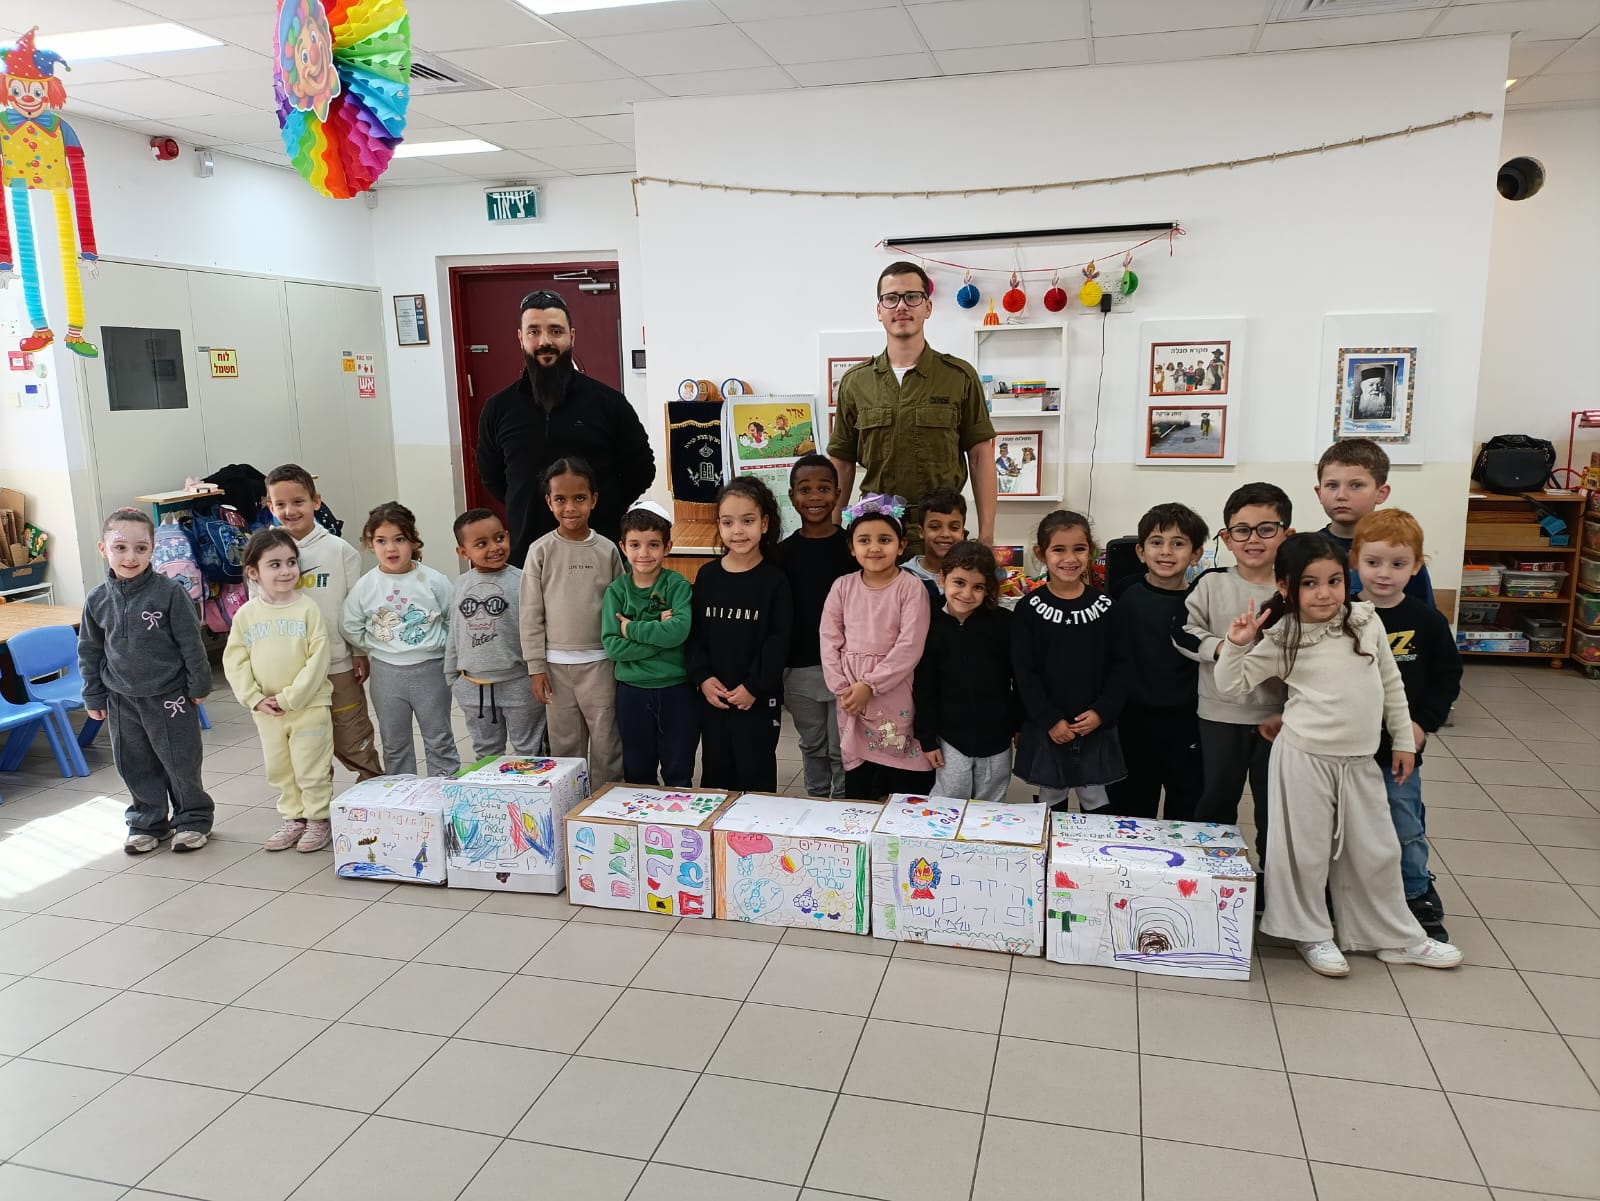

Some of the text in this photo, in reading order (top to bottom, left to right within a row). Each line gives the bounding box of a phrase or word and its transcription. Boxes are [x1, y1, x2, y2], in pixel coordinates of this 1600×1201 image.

[493, 191, 529, 219] יציאה
[217, 351, 230, 362] לוח
[213, 362, 236, 374] חשמל
[360, 377, 374, 390] אש
[316, 573, 330, 588] IT
[705, 606, 759, 621] ARIZONA
[1029, 594, 1112, 625] GOOD TIMES
[276, 619, 307, 639] YOR
